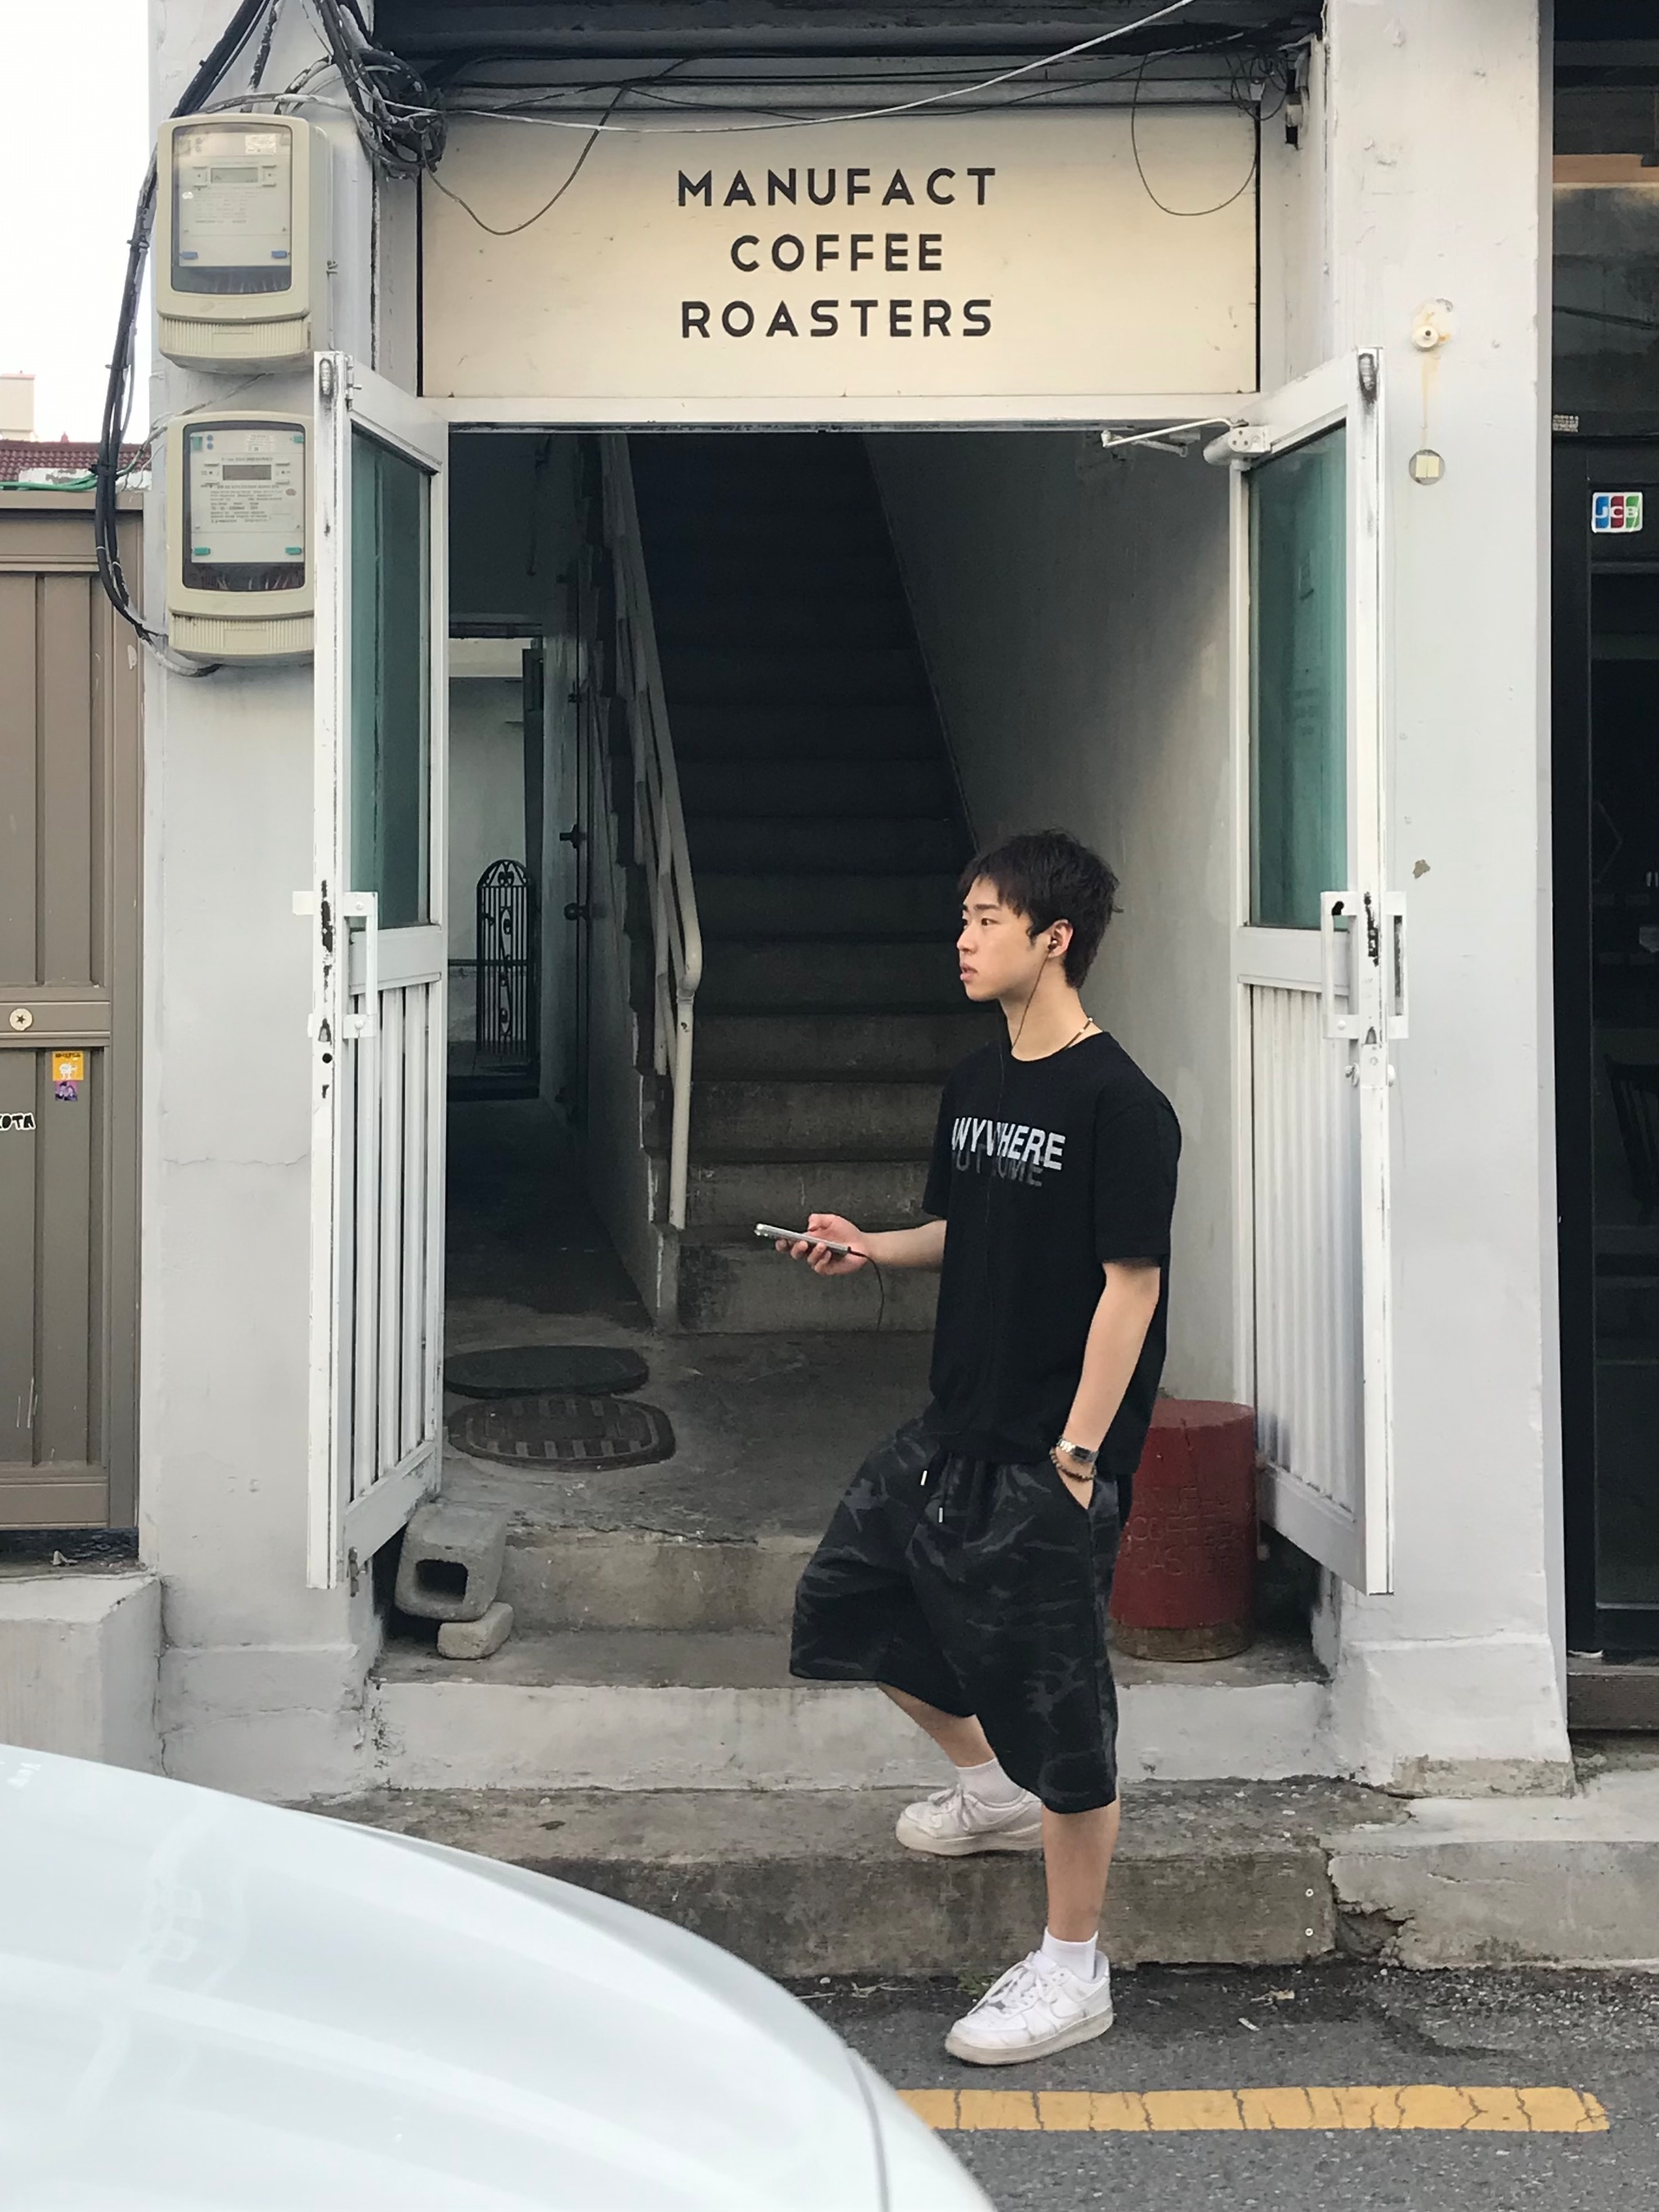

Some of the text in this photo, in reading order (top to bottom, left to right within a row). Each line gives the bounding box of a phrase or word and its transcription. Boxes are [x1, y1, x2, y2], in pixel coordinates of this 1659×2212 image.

[678, 167, 995, 207] MANUFACT
[730, 233, 942, 272] COFFEE
[682, 299, 991, 339] ROASTERS
[1595, 506, 1638, 518] JCB
[0, 1113, 35, 1131] OTA
